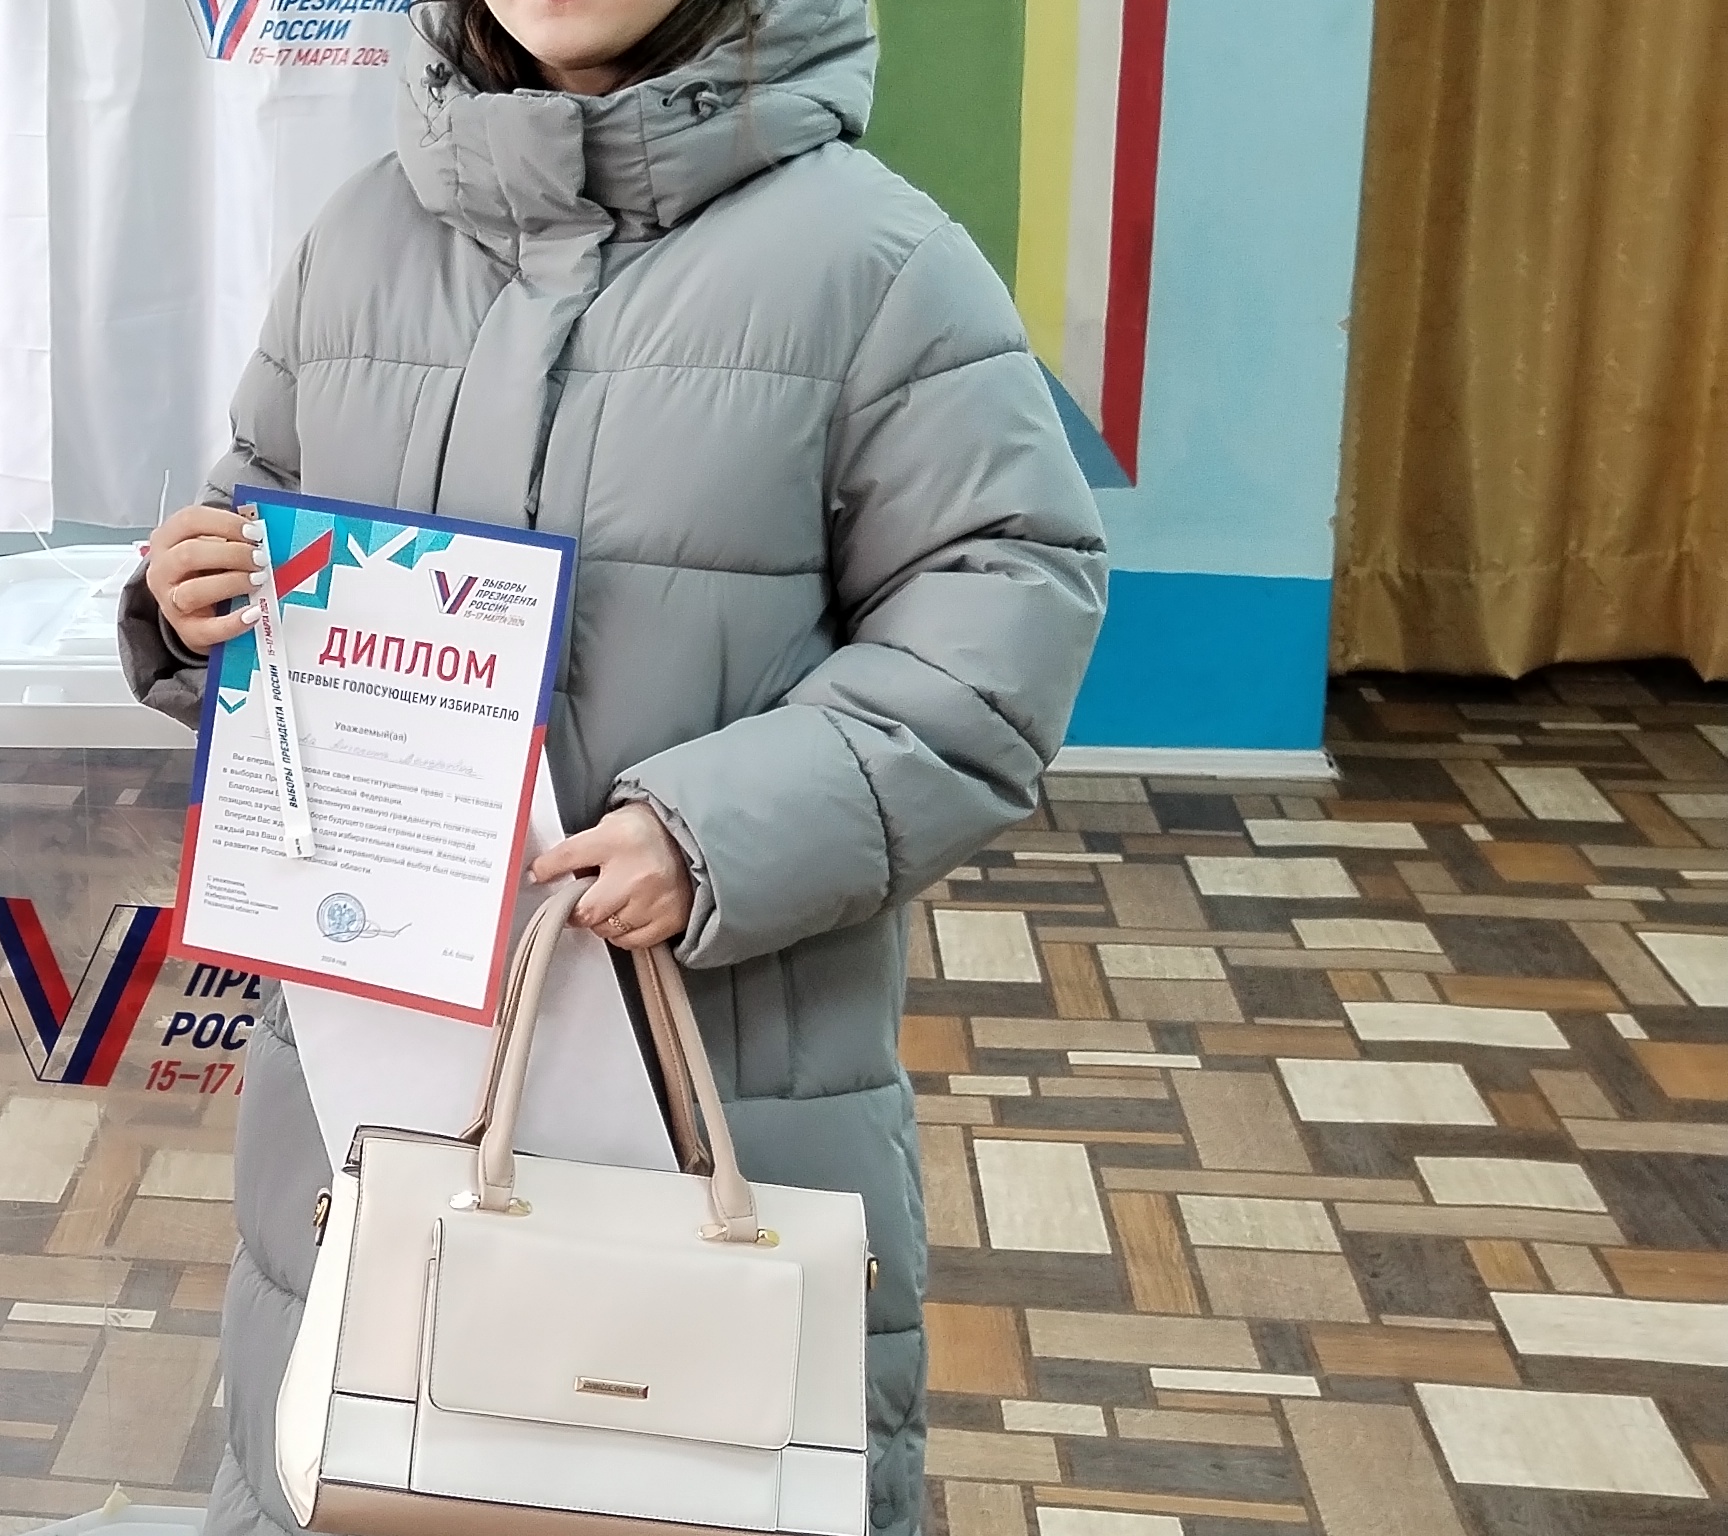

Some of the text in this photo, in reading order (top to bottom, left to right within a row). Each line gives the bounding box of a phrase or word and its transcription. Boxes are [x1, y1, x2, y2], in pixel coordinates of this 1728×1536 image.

[259, 19, 352, 41] РОССИИ
[292, 48, 349, 66] МАРТА
[351, 47, 390, 67] 2024
[482, 578, 527, 593] ВЫБОРЫ
[469, 599, 509, 613] РОССИИ
[475, 589, 538, 607] ПРЕЗИДЕНТА
[319, 626, 497, 689] ДИПЛОМ
[342, 680, 437, 706] ГОЛОСУЮЩЕМУ
[439, 697, 520, 722] ИЗБИРАТЕЛЮ
[269, 664, 298, 808] ВЫБОРЫ ПРЕЗИДЕНТА РОССИИ
[334, 721, 407, 744] Уважаемый(ая)
[233, 753, 244, 761] Вы
[246, 756, 275, 766] впервы
[302, 766, 330, 776] зовали
[228, 781, 274, 795] Благодарим
[230, 768, 263, 779] выборах
[312, 782, 357, 796] Российской
[225, 809, 256, 821] Впереди
[257, 816, 270, 824] Вас
[263, 804, 281, 812] учас
[310, 811, 328, 821] боре
[183, 962, 261, 999] ПРЕ
[161, 1012, 254, 1050] РОС
